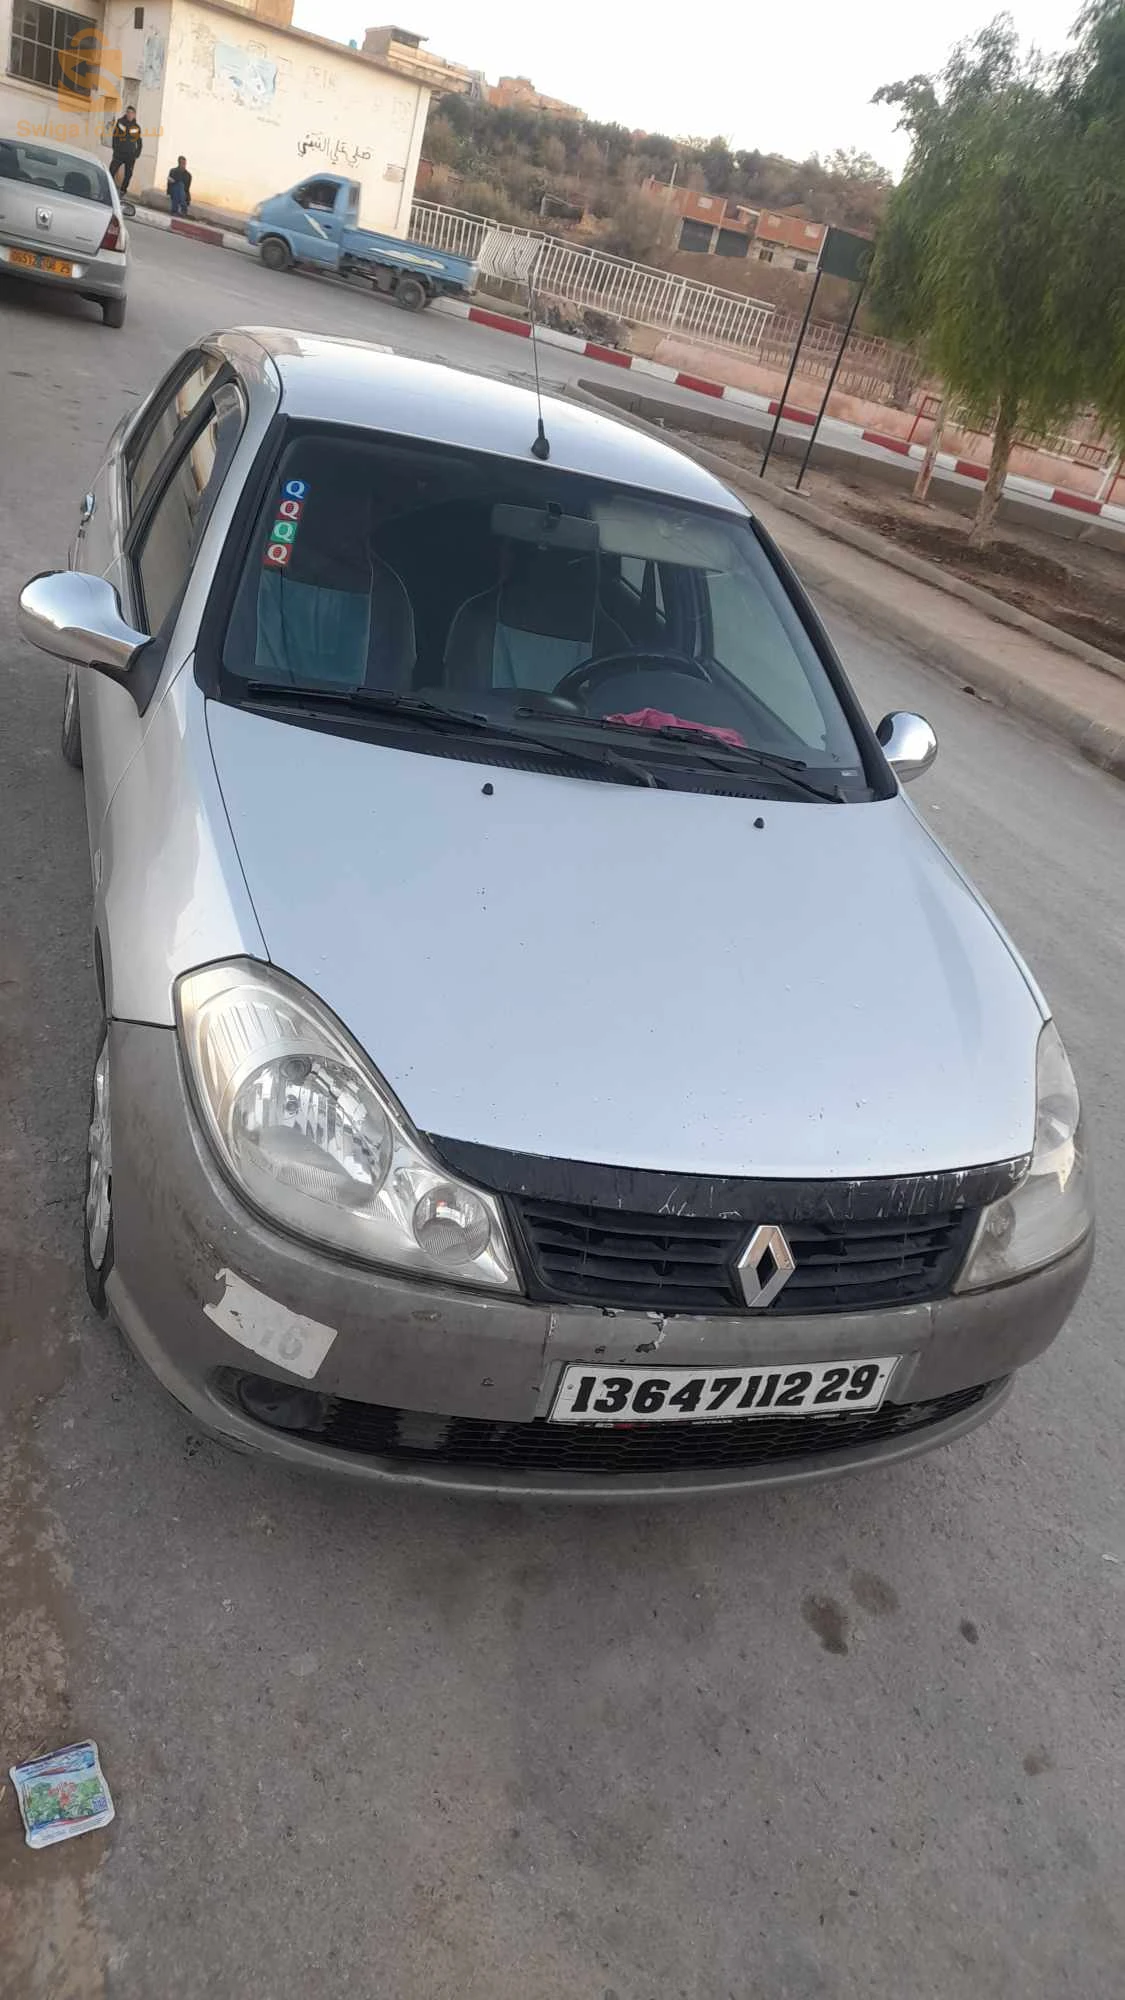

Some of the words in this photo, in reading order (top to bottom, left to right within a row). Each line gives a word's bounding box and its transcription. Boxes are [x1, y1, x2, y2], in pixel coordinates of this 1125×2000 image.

[286, 480, 305, 499] Q
[280, 500, 300, 520] Q
[273, 521, 294, 542] Q
[267, 543, 288, 565] Q
